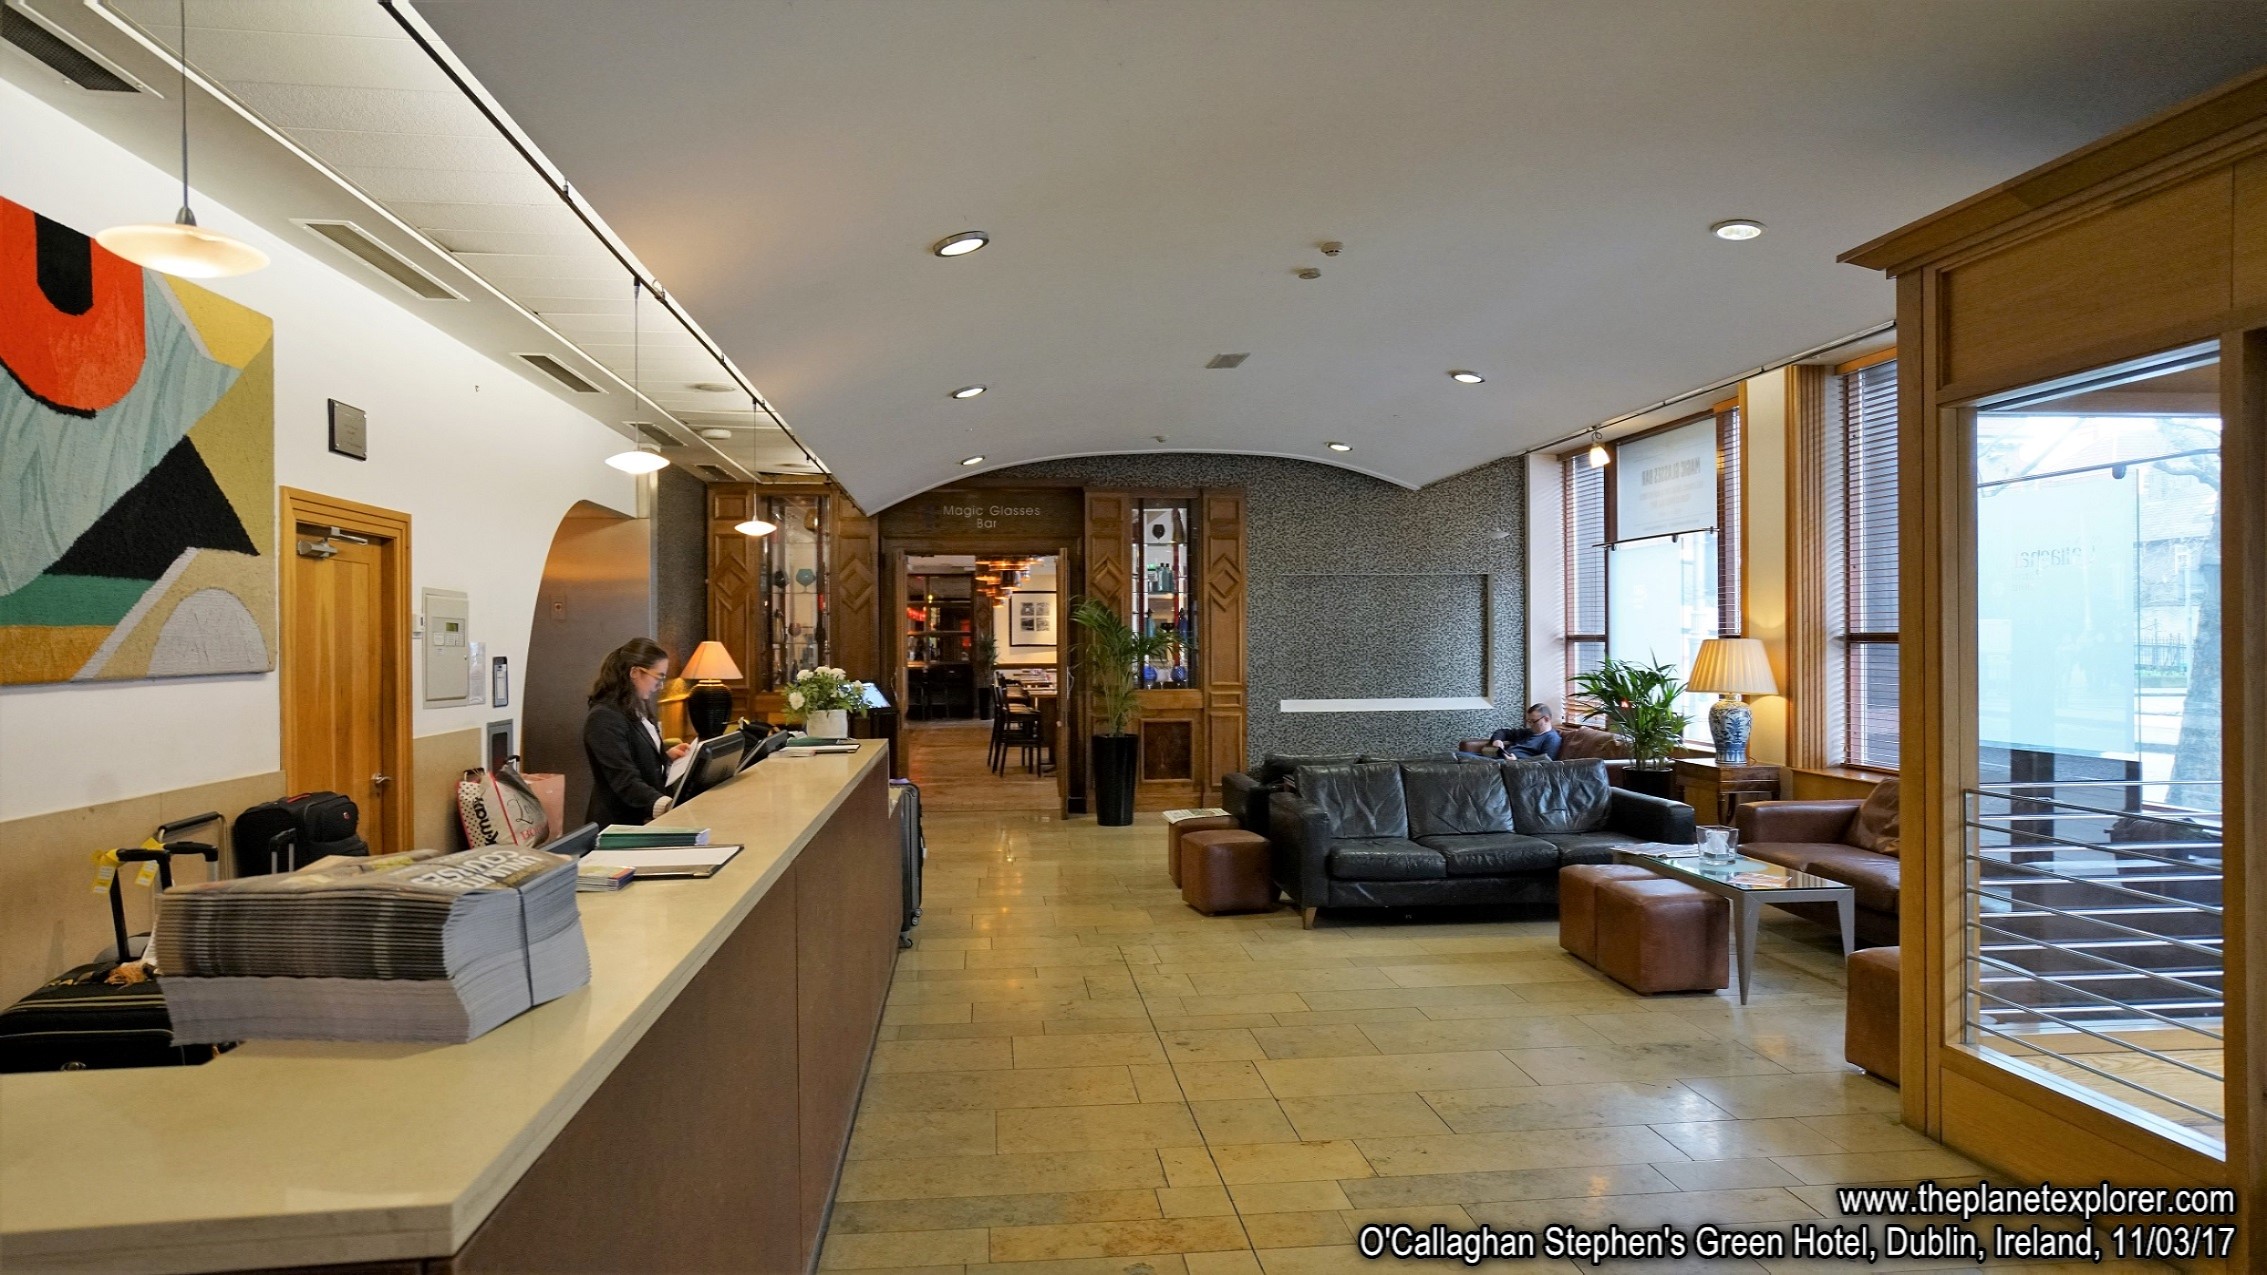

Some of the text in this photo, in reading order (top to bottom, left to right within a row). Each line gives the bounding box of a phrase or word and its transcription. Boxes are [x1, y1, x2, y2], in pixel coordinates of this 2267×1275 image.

[943, 505, 1041, 518] Magic Glasses
[976, 518, 997, 529] Bar
